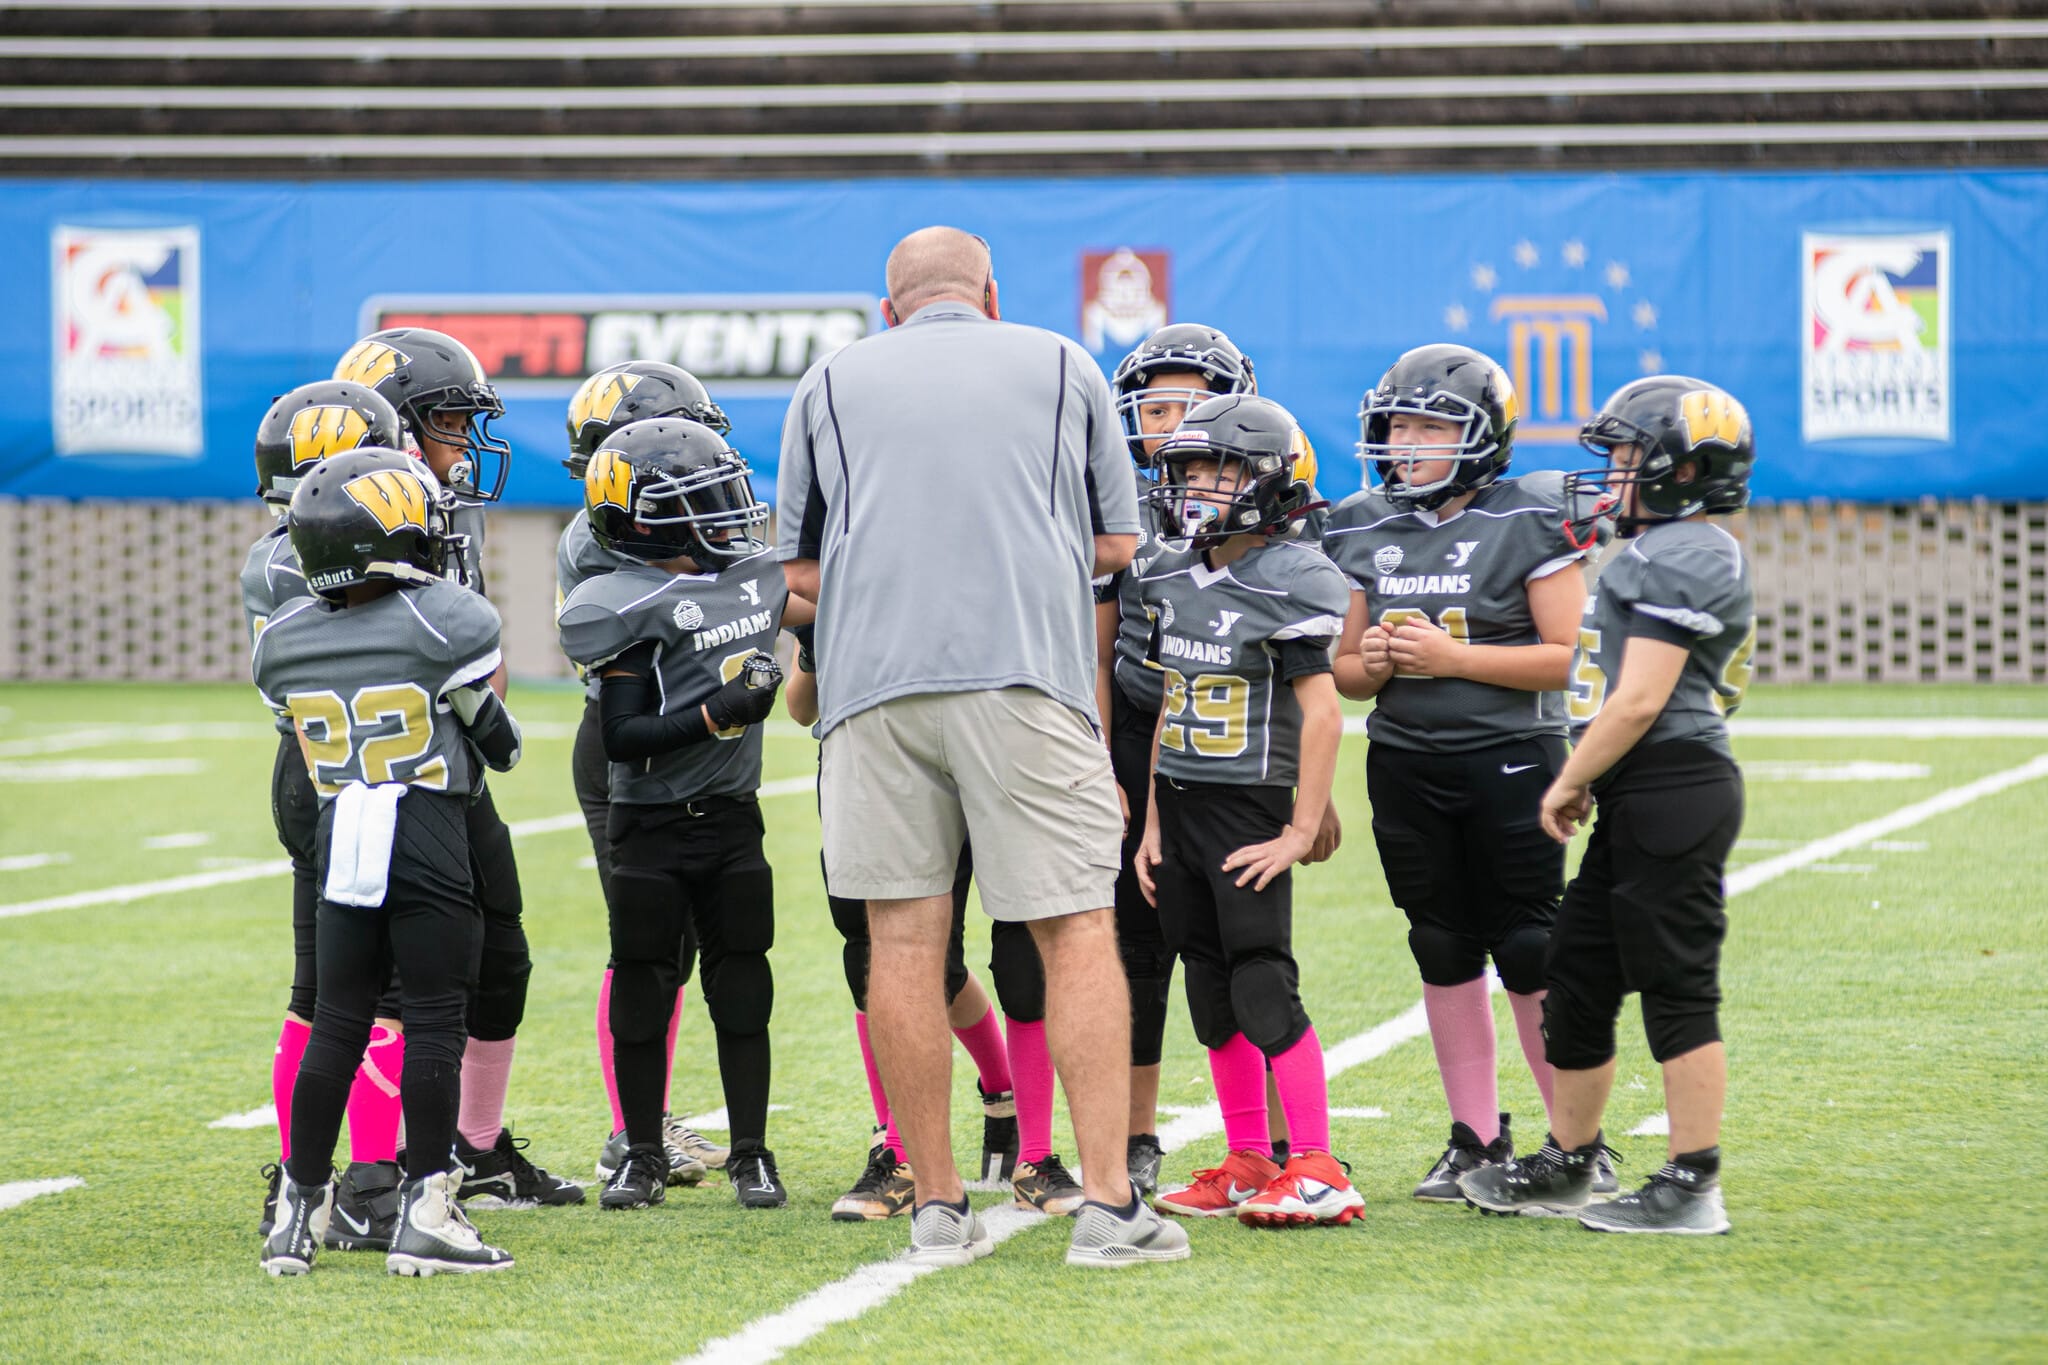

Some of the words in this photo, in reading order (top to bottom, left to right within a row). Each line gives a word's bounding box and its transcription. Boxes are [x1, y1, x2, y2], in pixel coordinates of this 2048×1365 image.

[588, 312, 867, 376] EVENTS
[1811, 380, 1941, 413] SPORTS
[311, 567, 355, 588] schutt
[1379, 574, 1472, 595] INDIANS
[693, 610, 772, 652] INDIANS
[1161, 634, 1232, 666] INDIANS
[1160, 666, 1250, 758] 29
[286, 682, 449, 797] 22
